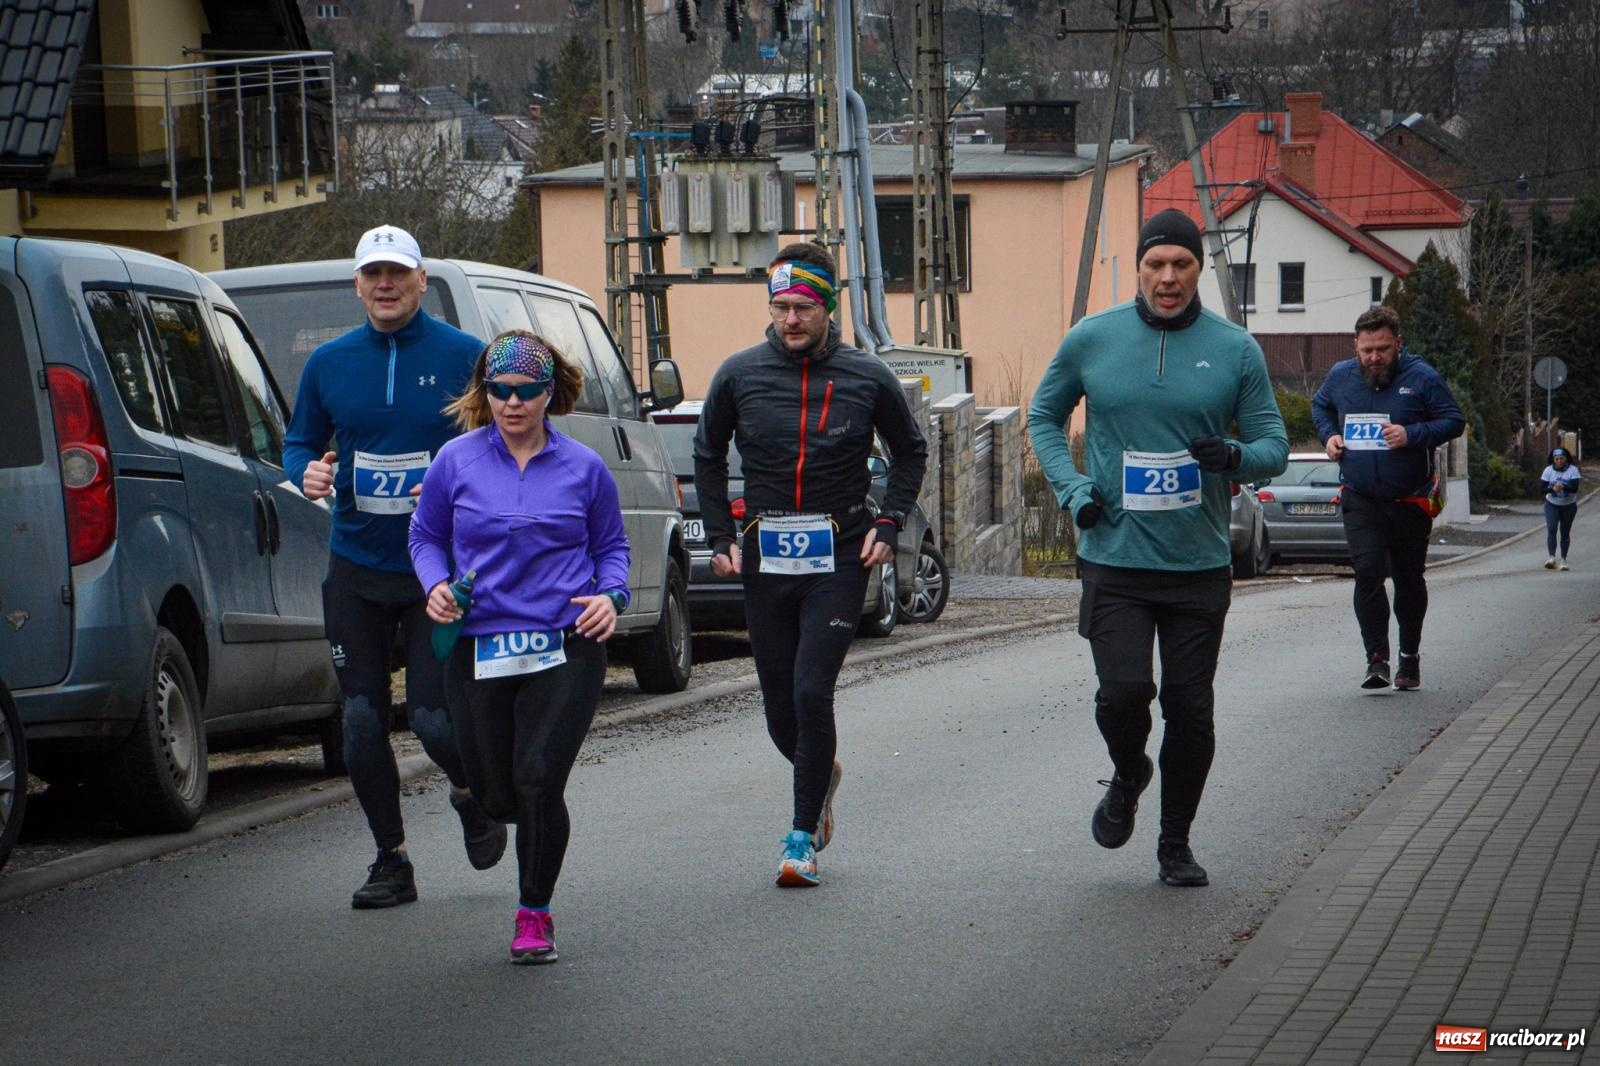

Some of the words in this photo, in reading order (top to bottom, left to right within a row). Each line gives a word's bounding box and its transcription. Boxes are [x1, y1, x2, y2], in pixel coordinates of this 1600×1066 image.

[894, 368, 924, 376] SZKOŁA
[916, 359, 946, 367] WIELKIE
[1351, 423, 1383, 439] 217
[372, 471, 407, 497] 27
[1144, 469, 1180, 493] 28
[778, 532, 810, 557] 59
[492, 631, 549, 658] 106
